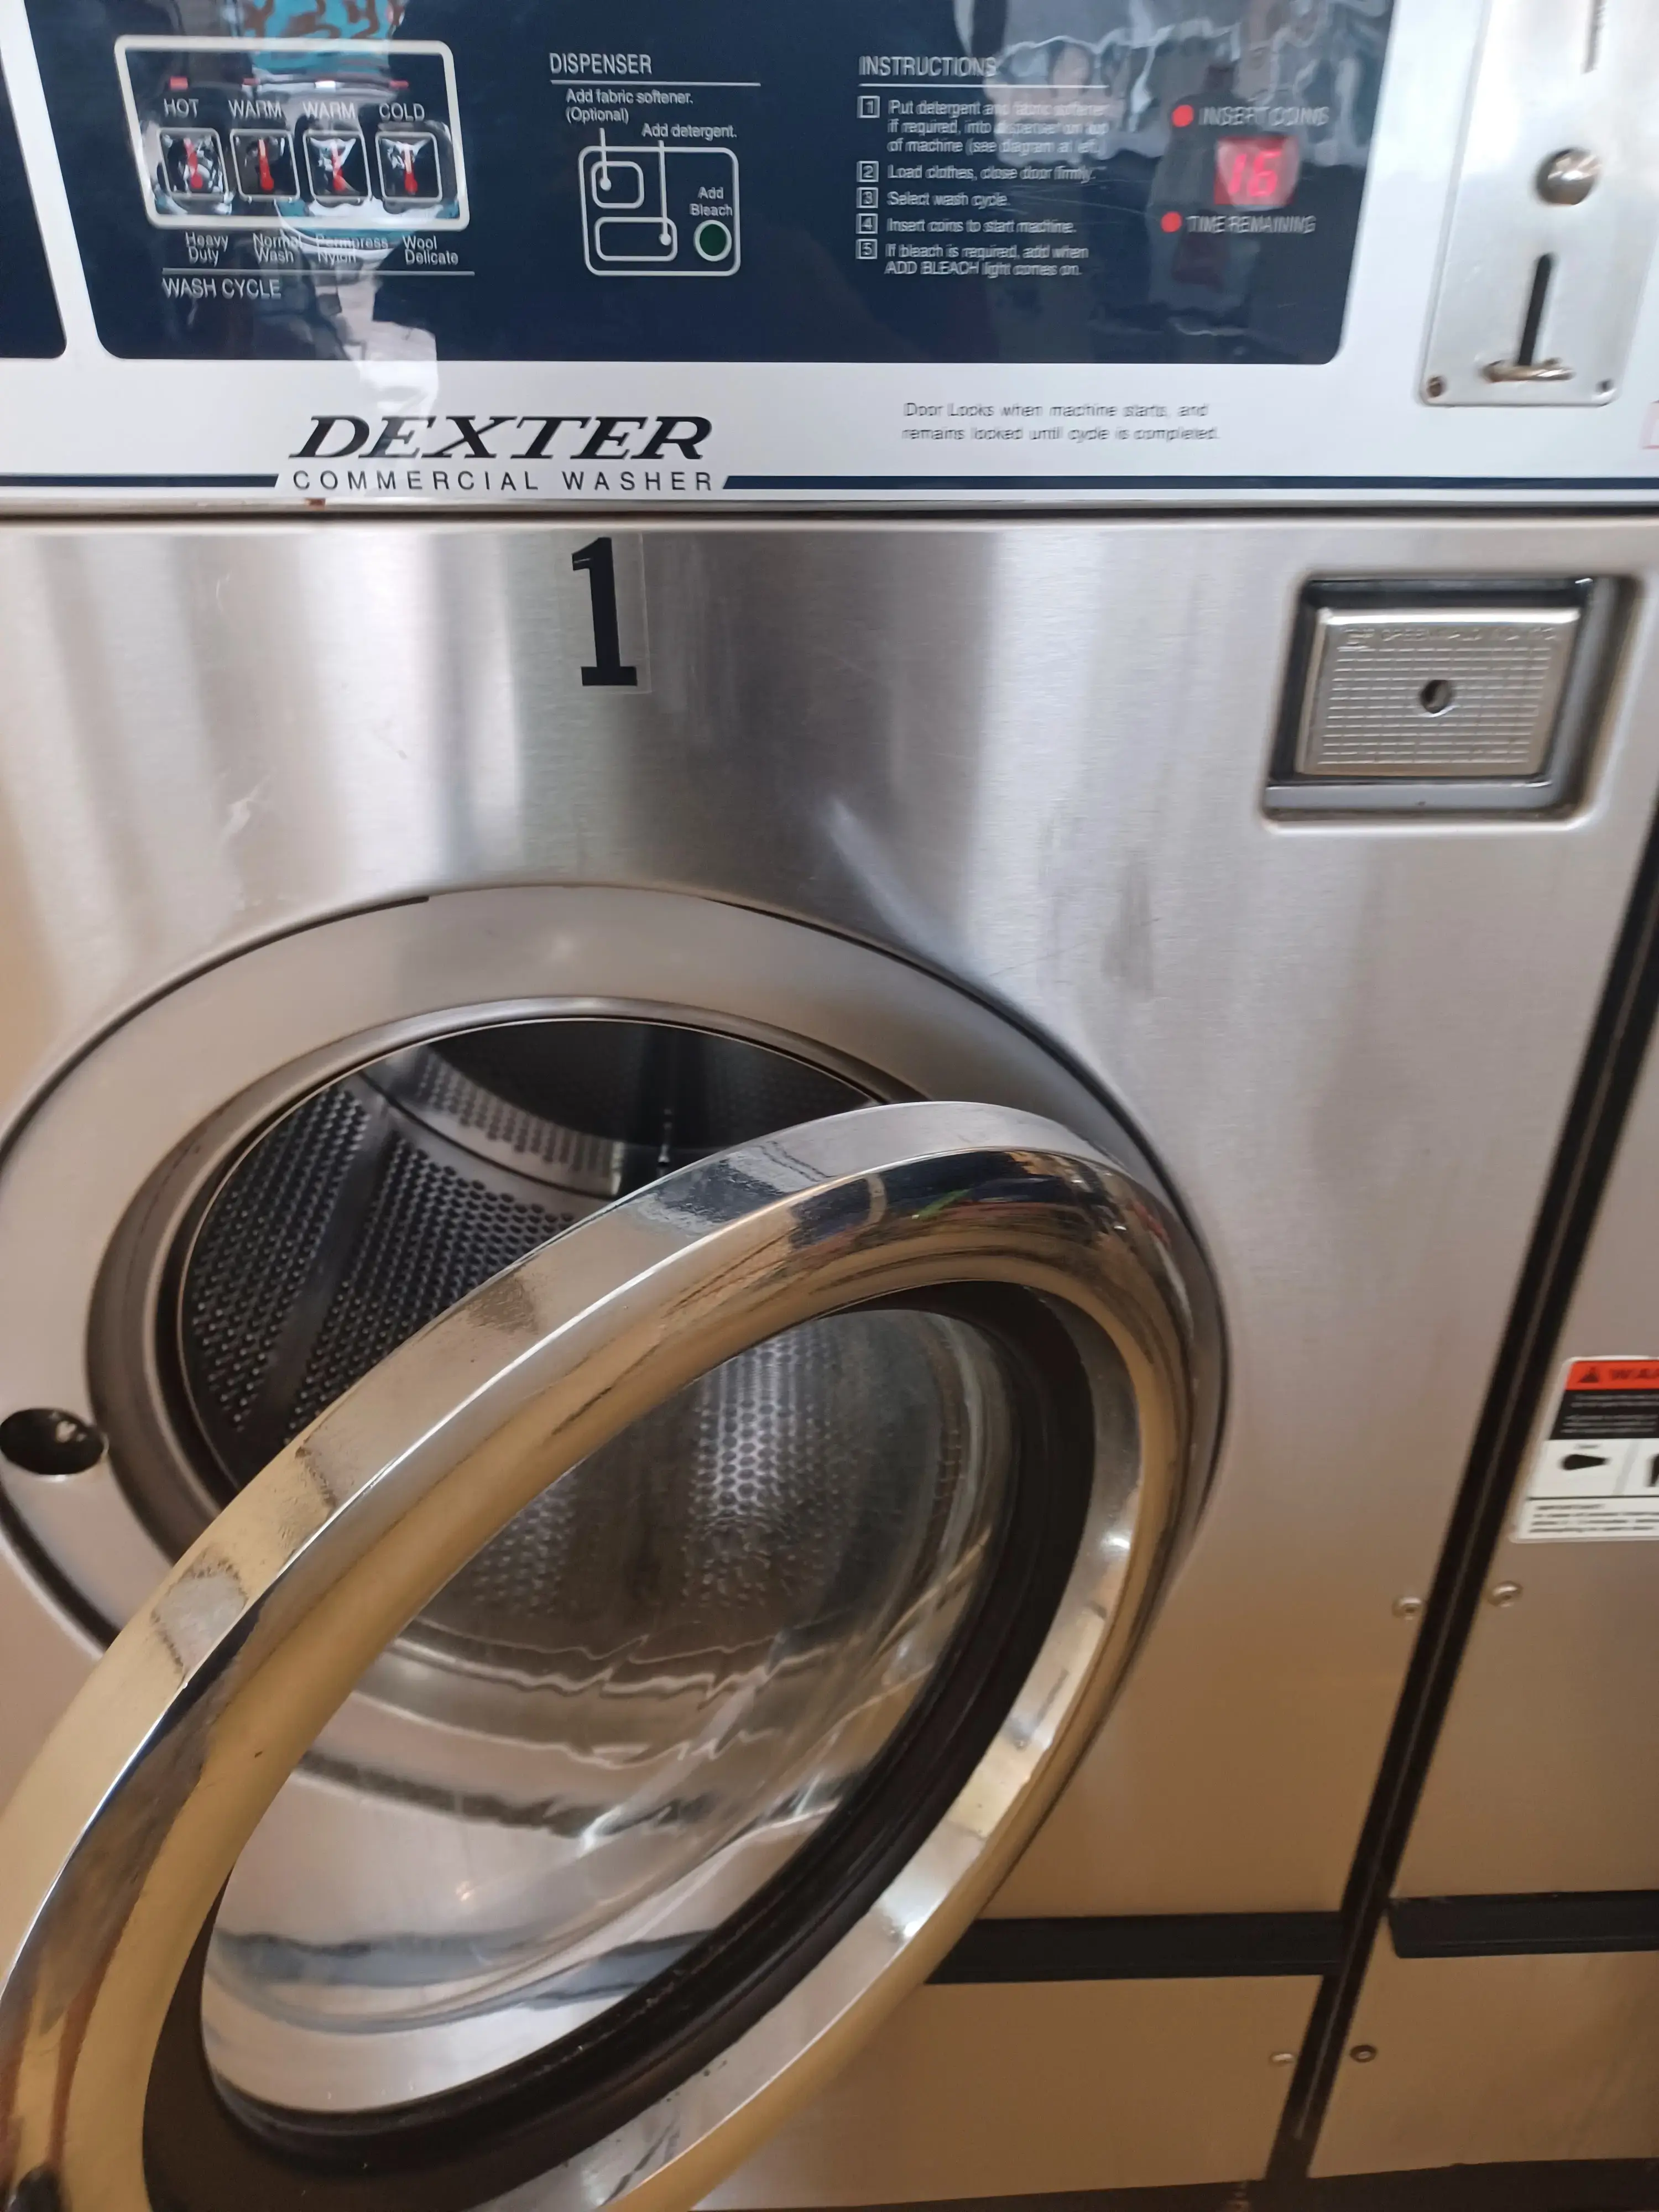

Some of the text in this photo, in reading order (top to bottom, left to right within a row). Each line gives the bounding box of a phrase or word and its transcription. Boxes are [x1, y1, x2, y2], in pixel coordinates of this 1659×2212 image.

[549, 53, 651, 75] DISPENSER
[859, 56, 996, 77] INSTRUCTIONS
[566, 88, 693, 104] Add fabric softener.
[164, 99, 199, 117] HOT
[228, 100, 283, 118] WARM
[303, 101, 355, 119] WARM
[379, 103, 425, 120] COLD
[566, 107, 629, 124] (Optional)
[888, 100, 914, 114] Put
[916, 100, 980, 118] detergent
[1199, 106, 1270, 126] INSERT
[641, 123, 737, 141] Add detergent.
[887, 118, 900, 133] if
[901, 119, 961, 137] required,
[964, 119, 992, 134] into
[887, 137, 904, 153] of
[905, 138, 963, 153] machine
[966, 138, 998, 155] (see
[887, 165, 922, 179] Load
[925, 165, 978, 181] clothes,
[980, 166, 1018, 180] close
[1020, 166, 1053, 180] door
[1228, 148, 1282, 197] 16
[697, 186, 723, 200] Add
[886, 191, 930, 206] Select
[933, 192, 969, 206] wash
[971, 192, 1011, 210] cycle.
[689, 203, 733, 216] Bleach
[886, 218, 926, 232] Insert
[927, 218, 964, 232] coins
[966, 219, 982, 232] to
[983, 220, 1015, 233] start
[1016, 219, 1078, 233] machine.
[1186, 215, 1317, 234] TIME REMAINING
[185, 232, 229, 252] Heavy
[253, 232, 302, 249] Normal
[402, 235, 437, 251] Wool
[188, 247, 220, 268] Duty
[255, 247, 294, 264] Wash
[317, 247, 357, 264] Nylon
[405, 248, 459, 265] Delicate
[885, 244, 897, 257] If
[899, 244, 944, 258] bleach
[946, 244, 959, 258] is
[961, 244, 1020, 260] required,
[1021, 244, 1051, 258] add
[1051, 245, 1089, 258] when
[883, 260, 1083, 278] ADD BLEACH light comes on.
[161, 278, 281, 299] WASH CYCLE
[904, 403, 944, 416] Door
[1000, 403, 1043, 416] when
[1049, 403, 1118, 416] machine
[1177, 403, 1210, 416] and
[288, 415, 712, 460] DEXTER
[901, 427, 966, 440] remains
[970, 426, 1024, 440] locked
[1028, 426, 1065, 440] until
[1067, 426, 1110, 443] cycle
[1114, 426, 1130, 440] is
[293, 470, 712, 492] COMMERCIAL WASHER
[572, 537, 638, 686] 1
